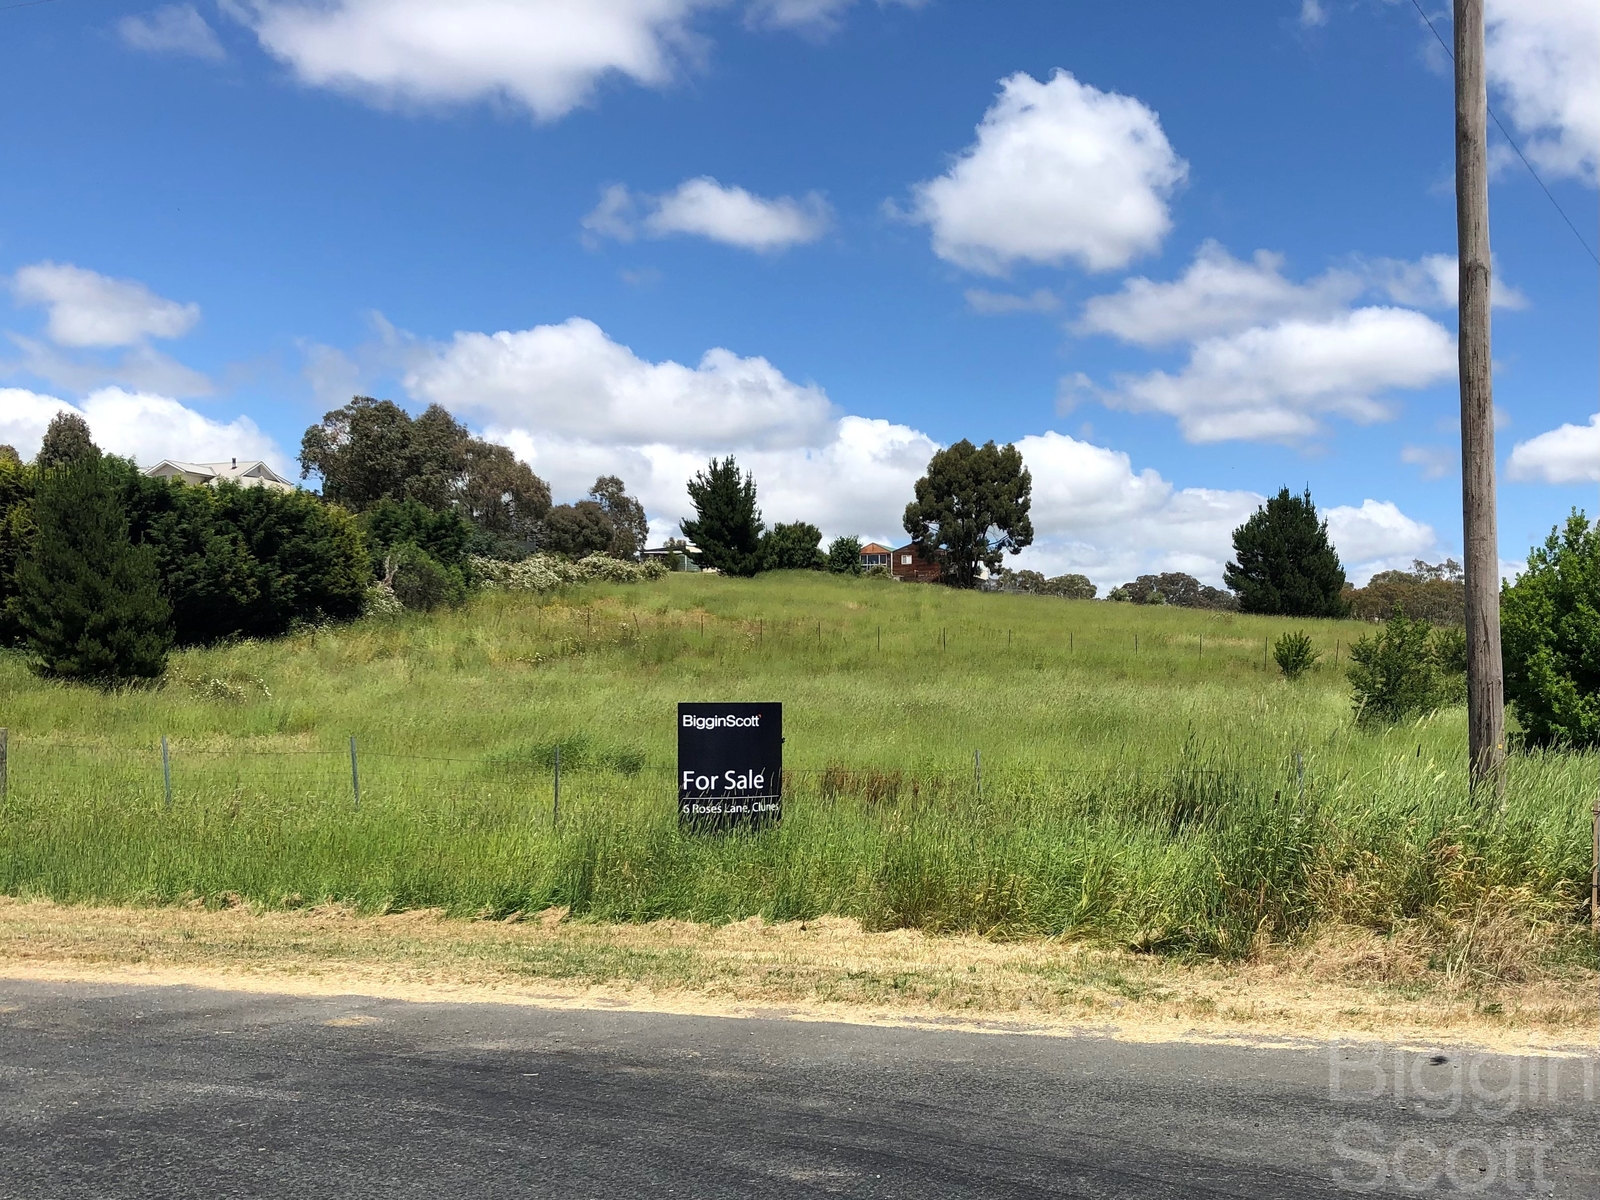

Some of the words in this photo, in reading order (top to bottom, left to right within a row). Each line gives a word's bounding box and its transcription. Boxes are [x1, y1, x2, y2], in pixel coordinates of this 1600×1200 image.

[683, 715, 759, 730] BigginScott
[683, 771, 719, 790] For
[724, 769, 764, 790] Sale
[683, 804, 690, 814] 6
[692, 804, 722, 814] Roses
[752, 802, 779, 812] Clunes
